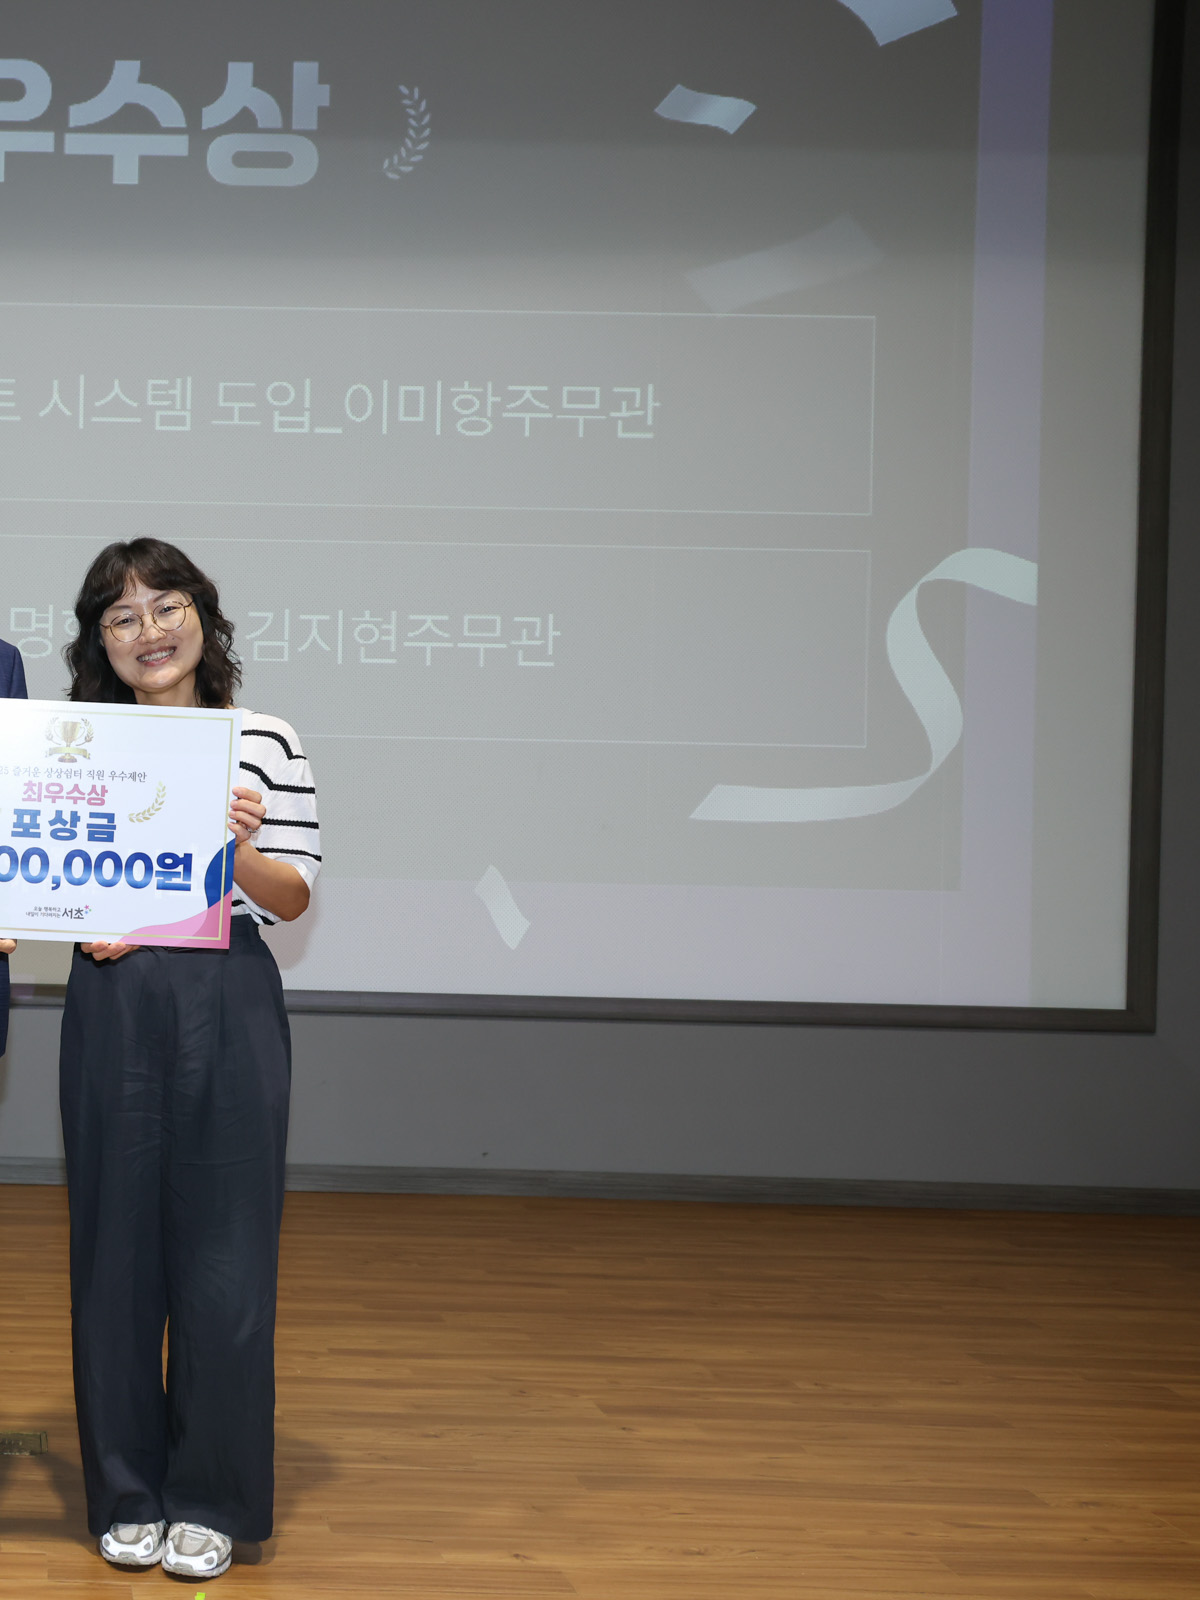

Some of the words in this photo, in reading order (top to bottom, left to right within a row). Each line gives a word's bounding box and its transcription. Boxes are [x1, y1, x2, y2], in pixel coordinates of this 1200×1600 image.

[38, 374, 194, 432] 시스템
[239, 608, 561, 667] 김지현주무관
[22, 780, 108, 806] 최우수상
[11, 808, 117, 843] 포상금
[62, 907, 84, 919] 서초
